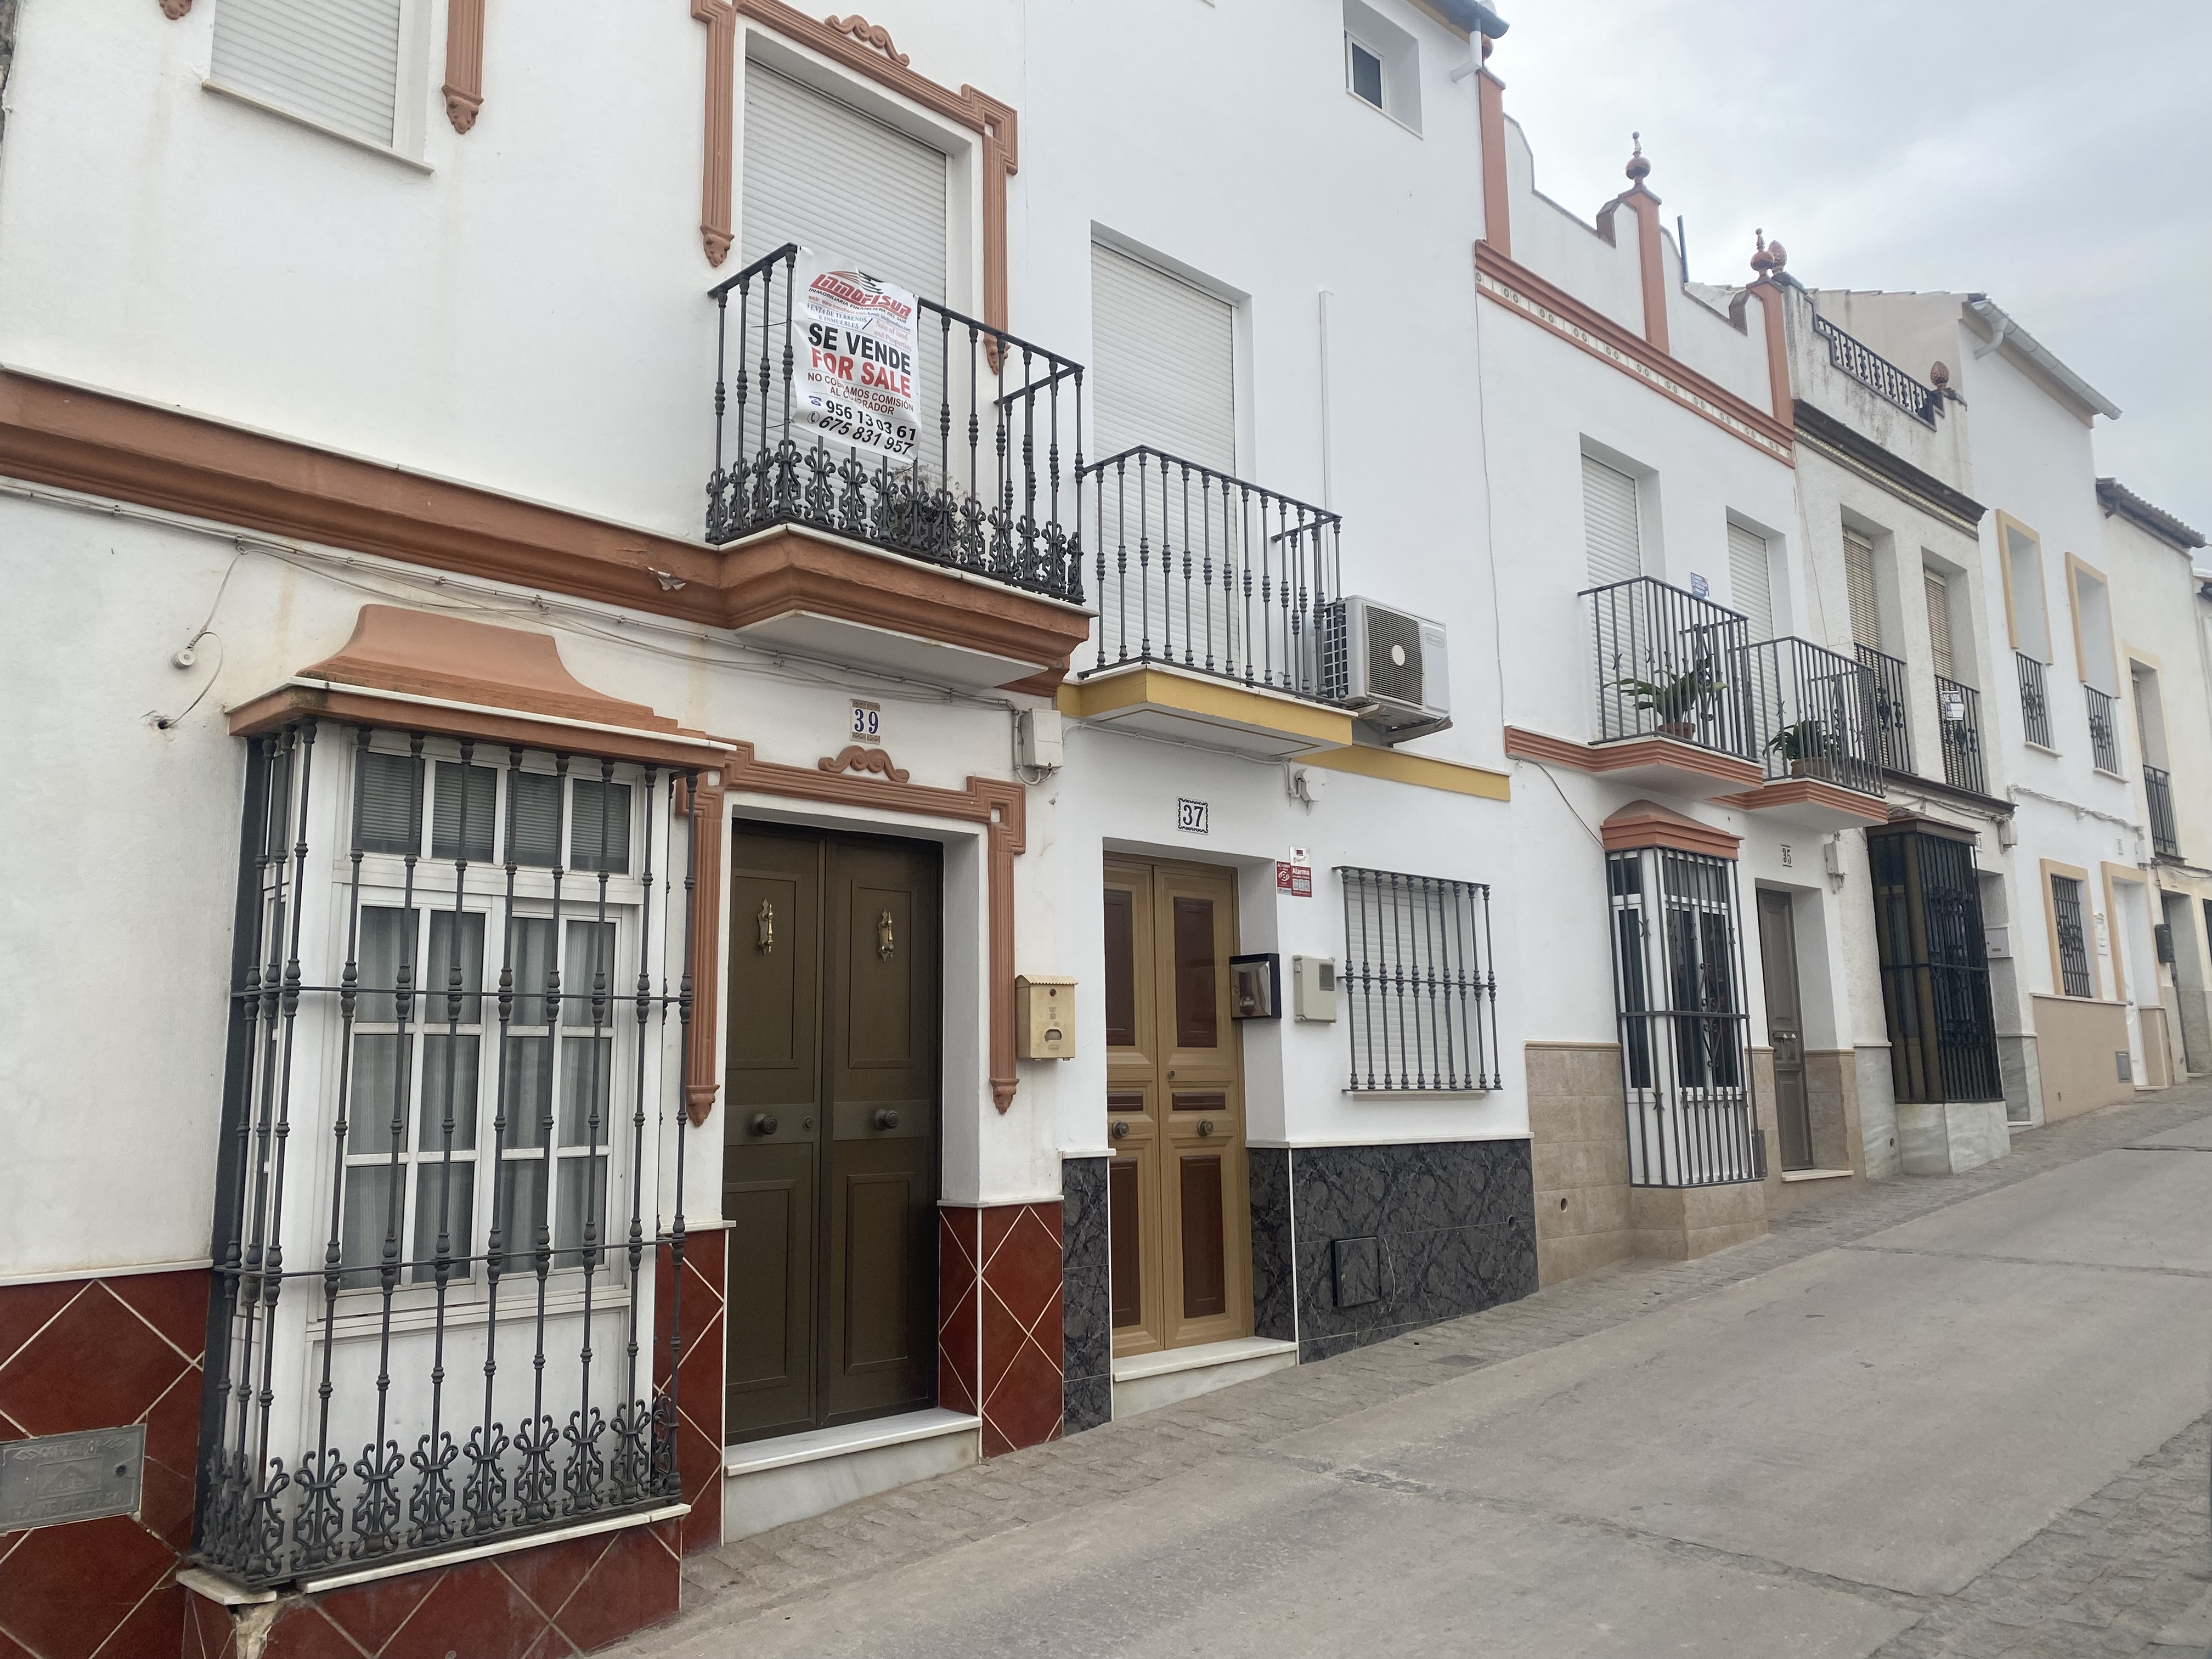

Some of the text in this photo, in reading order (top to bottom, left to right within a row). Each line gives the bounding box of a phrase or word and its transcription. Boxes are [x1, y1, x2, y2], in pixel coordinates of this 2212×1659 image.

[809, 287, 848, 306] INMOBILIARIA
[850, 304, 885, 313] FINANCIERA
[807, 302, 825, 314] VENTA
[836, 313, 867, 322] TERRENOS
[825, 317, 859, 329] INMUEBLES
[874, 330, 912, 352] and Properties
[877, 320, 888, 330] Sale
[896, 330, 908, 340] land
[808, 323, 911, 376] SE VENDE
[811, 347, 911, 398] FOR SALE
[808, 373, 822, 382] NO
[872, 392, 913, 412] COMISIÓN
[830, 387, 840, 396] AL
[826, 400, 916, 441] 956 13 03 61
[819, 416, 915, 455] 675 831 957
[1943, 693, 1950, 702] SE
[854, 709, 878, 734] 39
[1183, 804, 1204, 827] 37
[1782, 848, 1792, 865] 35
